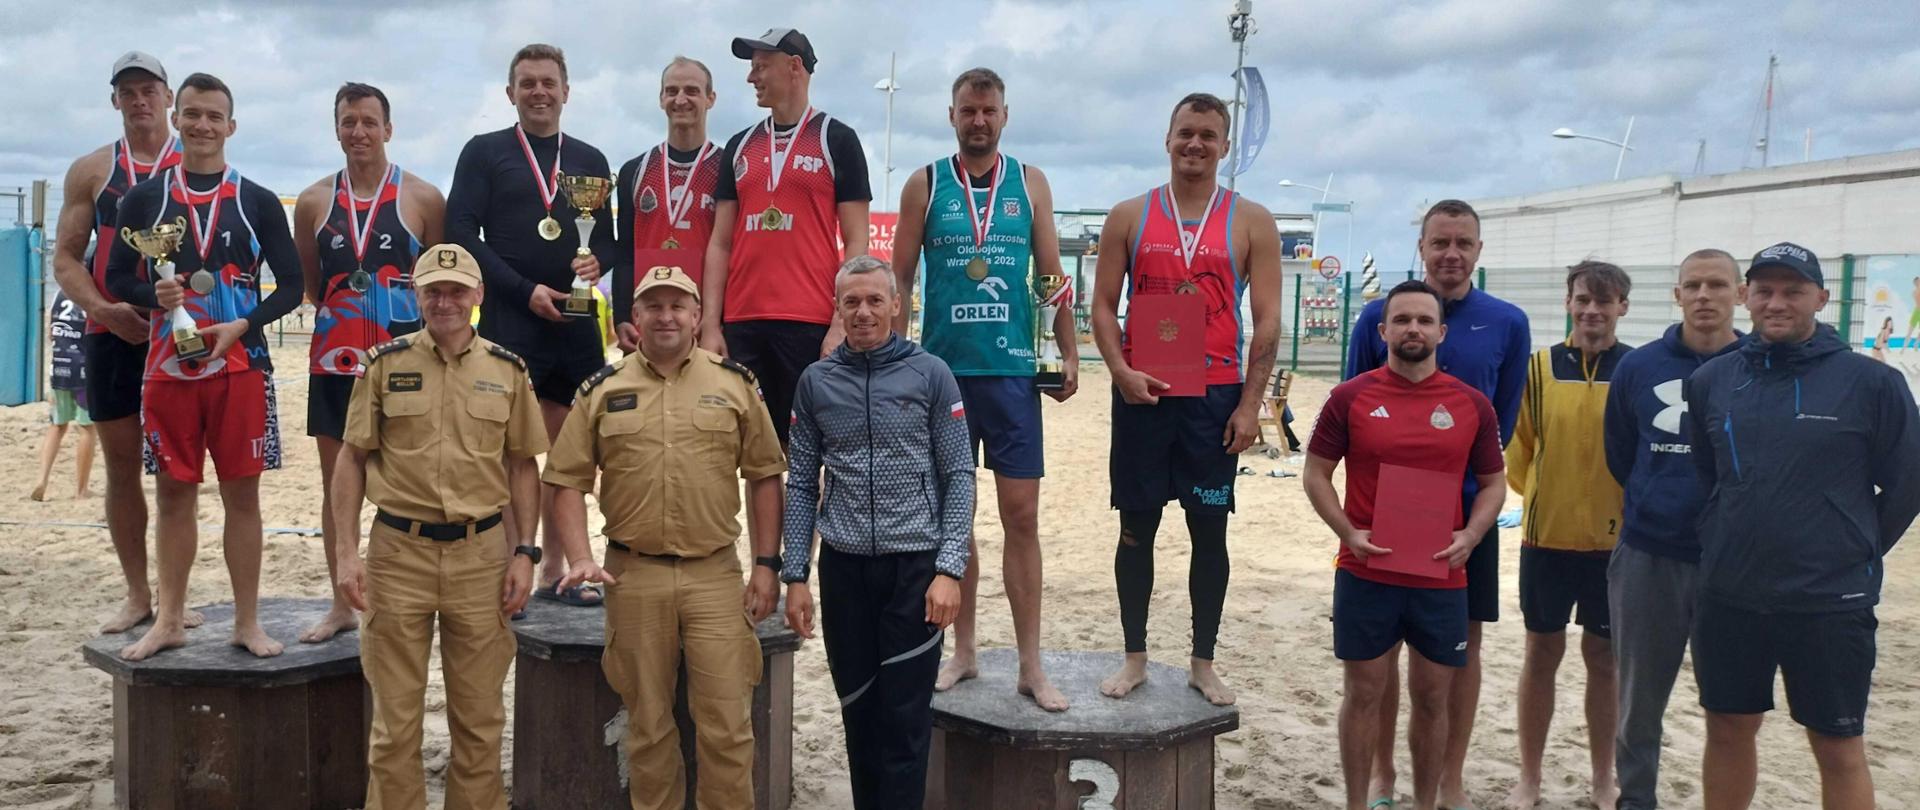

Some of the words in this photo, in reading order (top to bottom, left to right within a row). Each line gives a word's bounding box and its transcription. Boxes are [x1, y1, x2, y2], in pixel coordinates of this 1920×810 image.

[793, 155, 823, 173] PSP
[746, 213, 794, 232] BYW
[221, 230, 231, 247] 1
[379, 233, 392, 250] 2
[944, 235, 972, 244] Orlen
[983, 234, 1026, 246] istrzostwa
[957, 244, 1006, 255] Oldbojów
[994, 256, 1016, 266] 2022
[58, 299, 74, 321] 2
[954, 306, 1006, 320] ORLEN
[1608, 518, 1616, 535] 2
